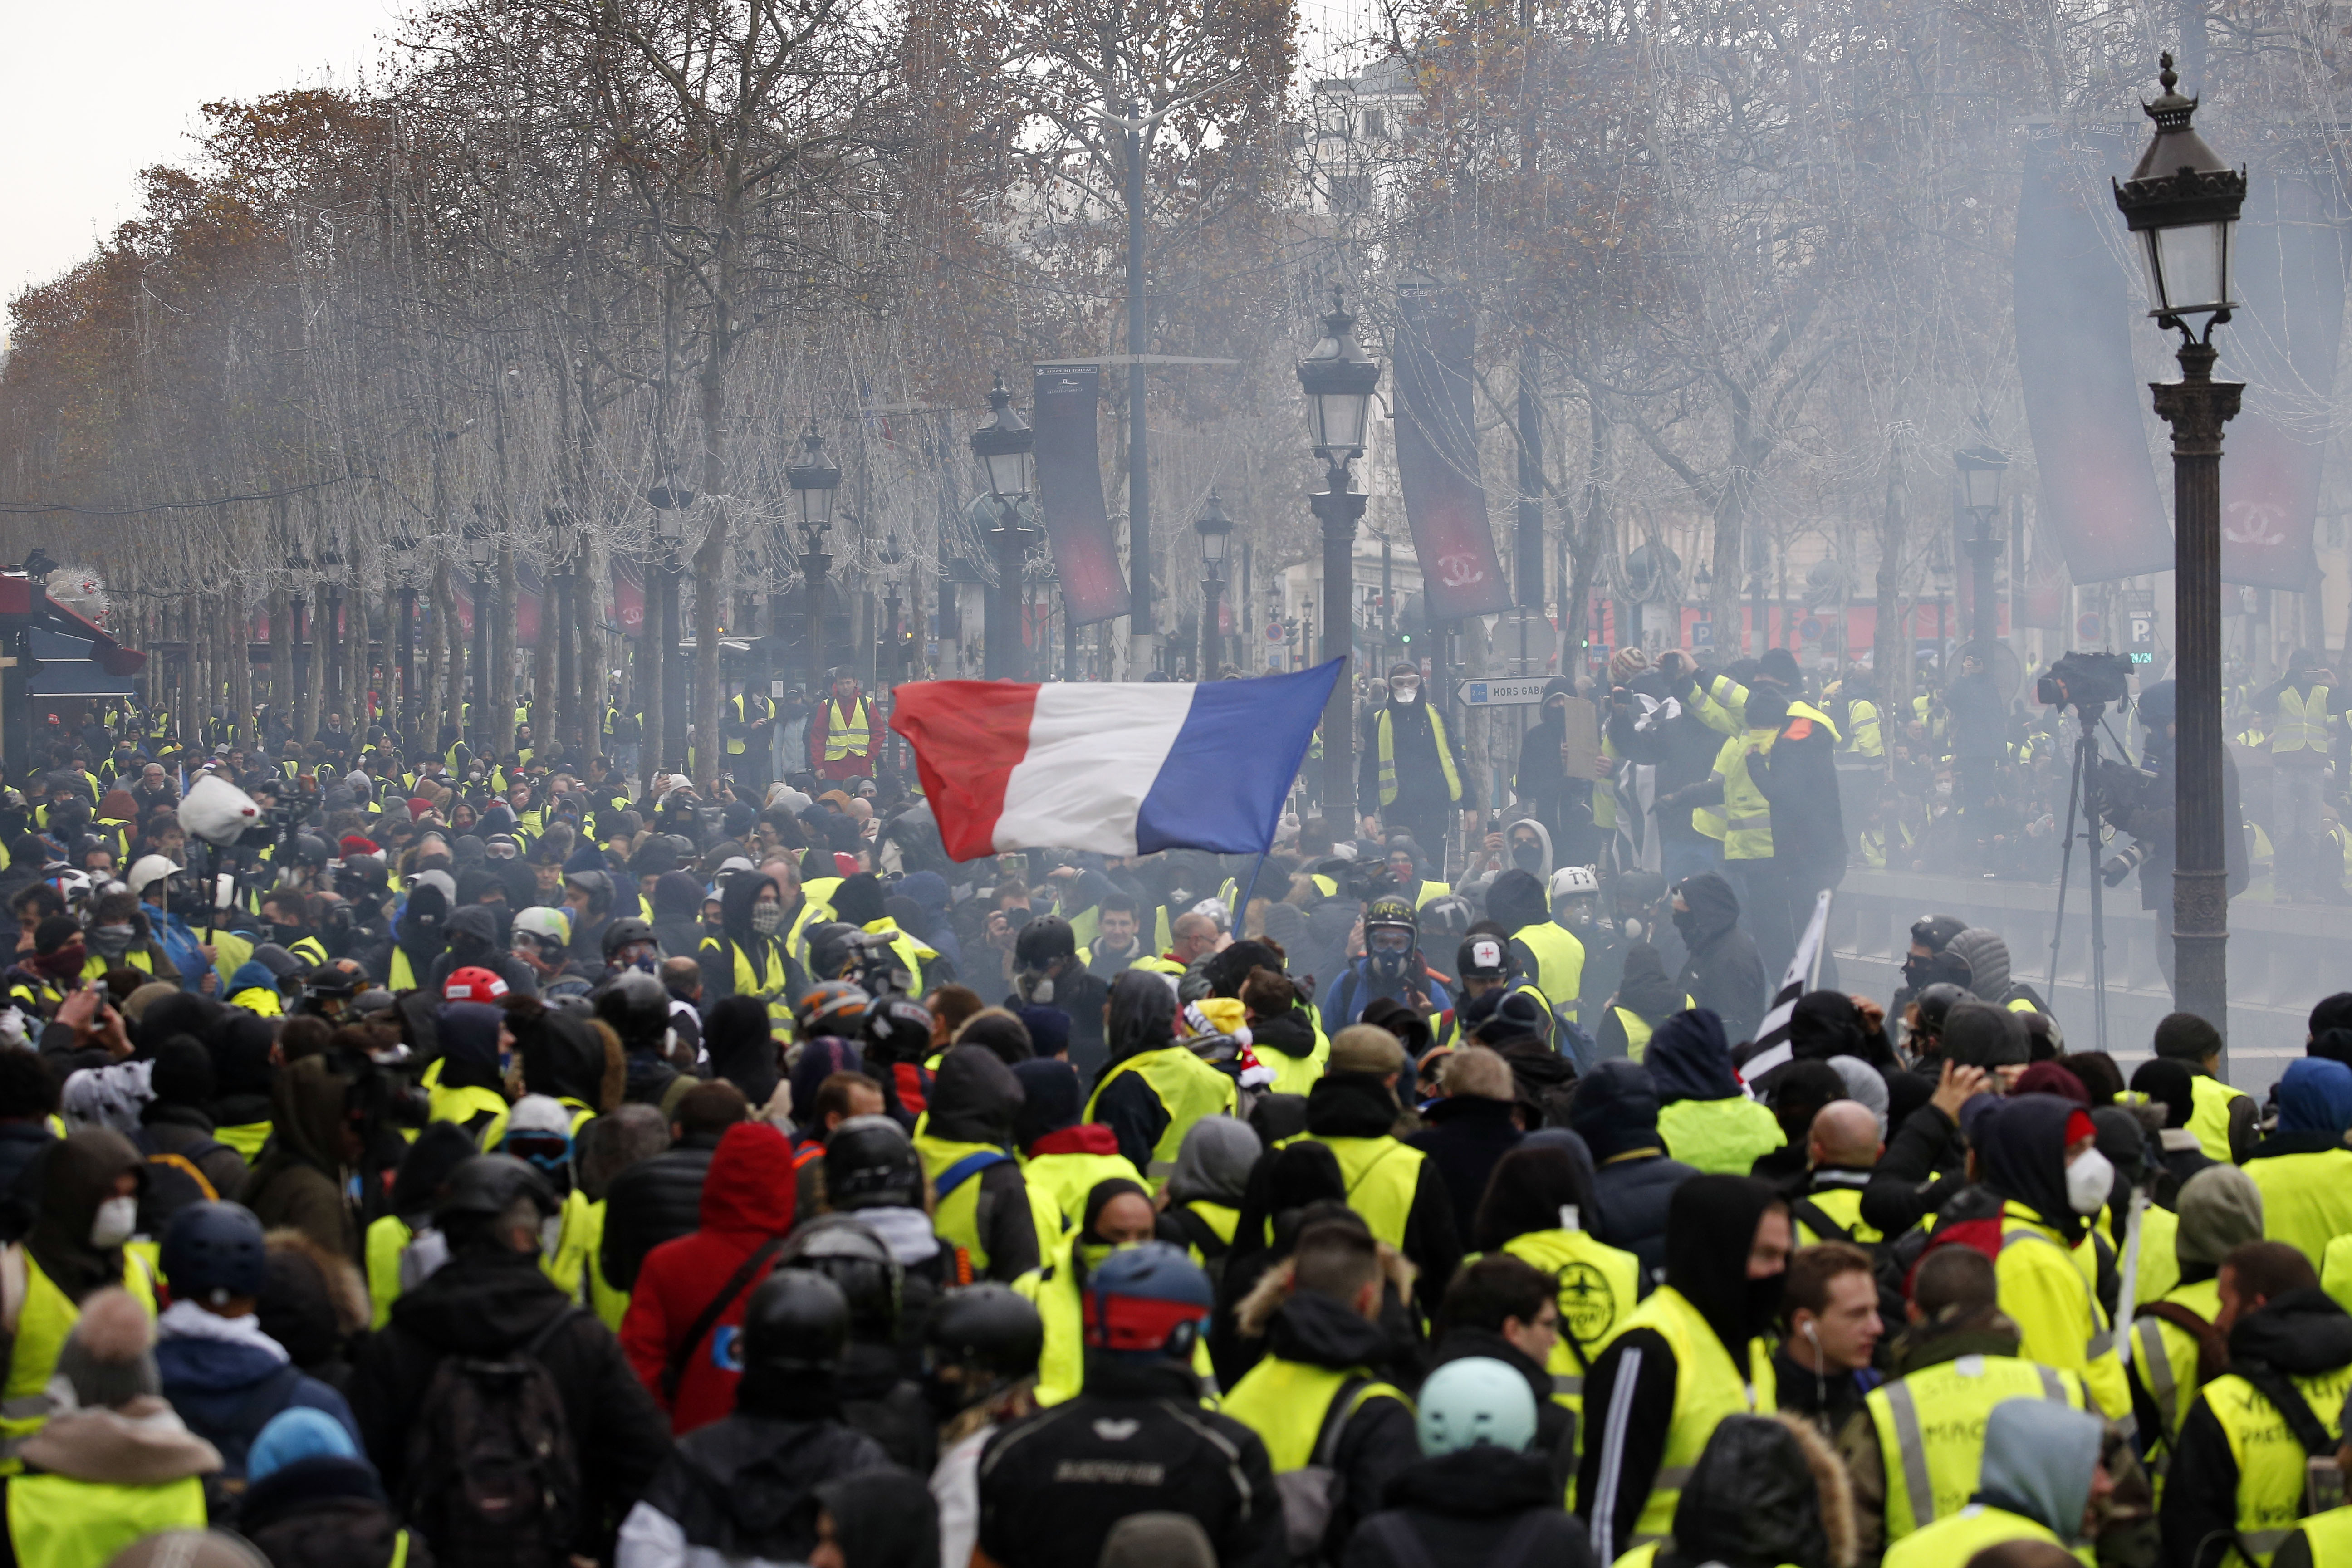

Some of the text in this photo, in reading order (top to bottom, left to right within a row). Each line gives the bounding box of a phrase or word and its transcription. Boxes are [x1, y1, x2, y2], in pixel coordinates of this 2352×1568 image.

[1698, 627, 1710, 643] P
[2132, 619, 2150, 642] P
[1494, 687, 1519, 696] HORS
